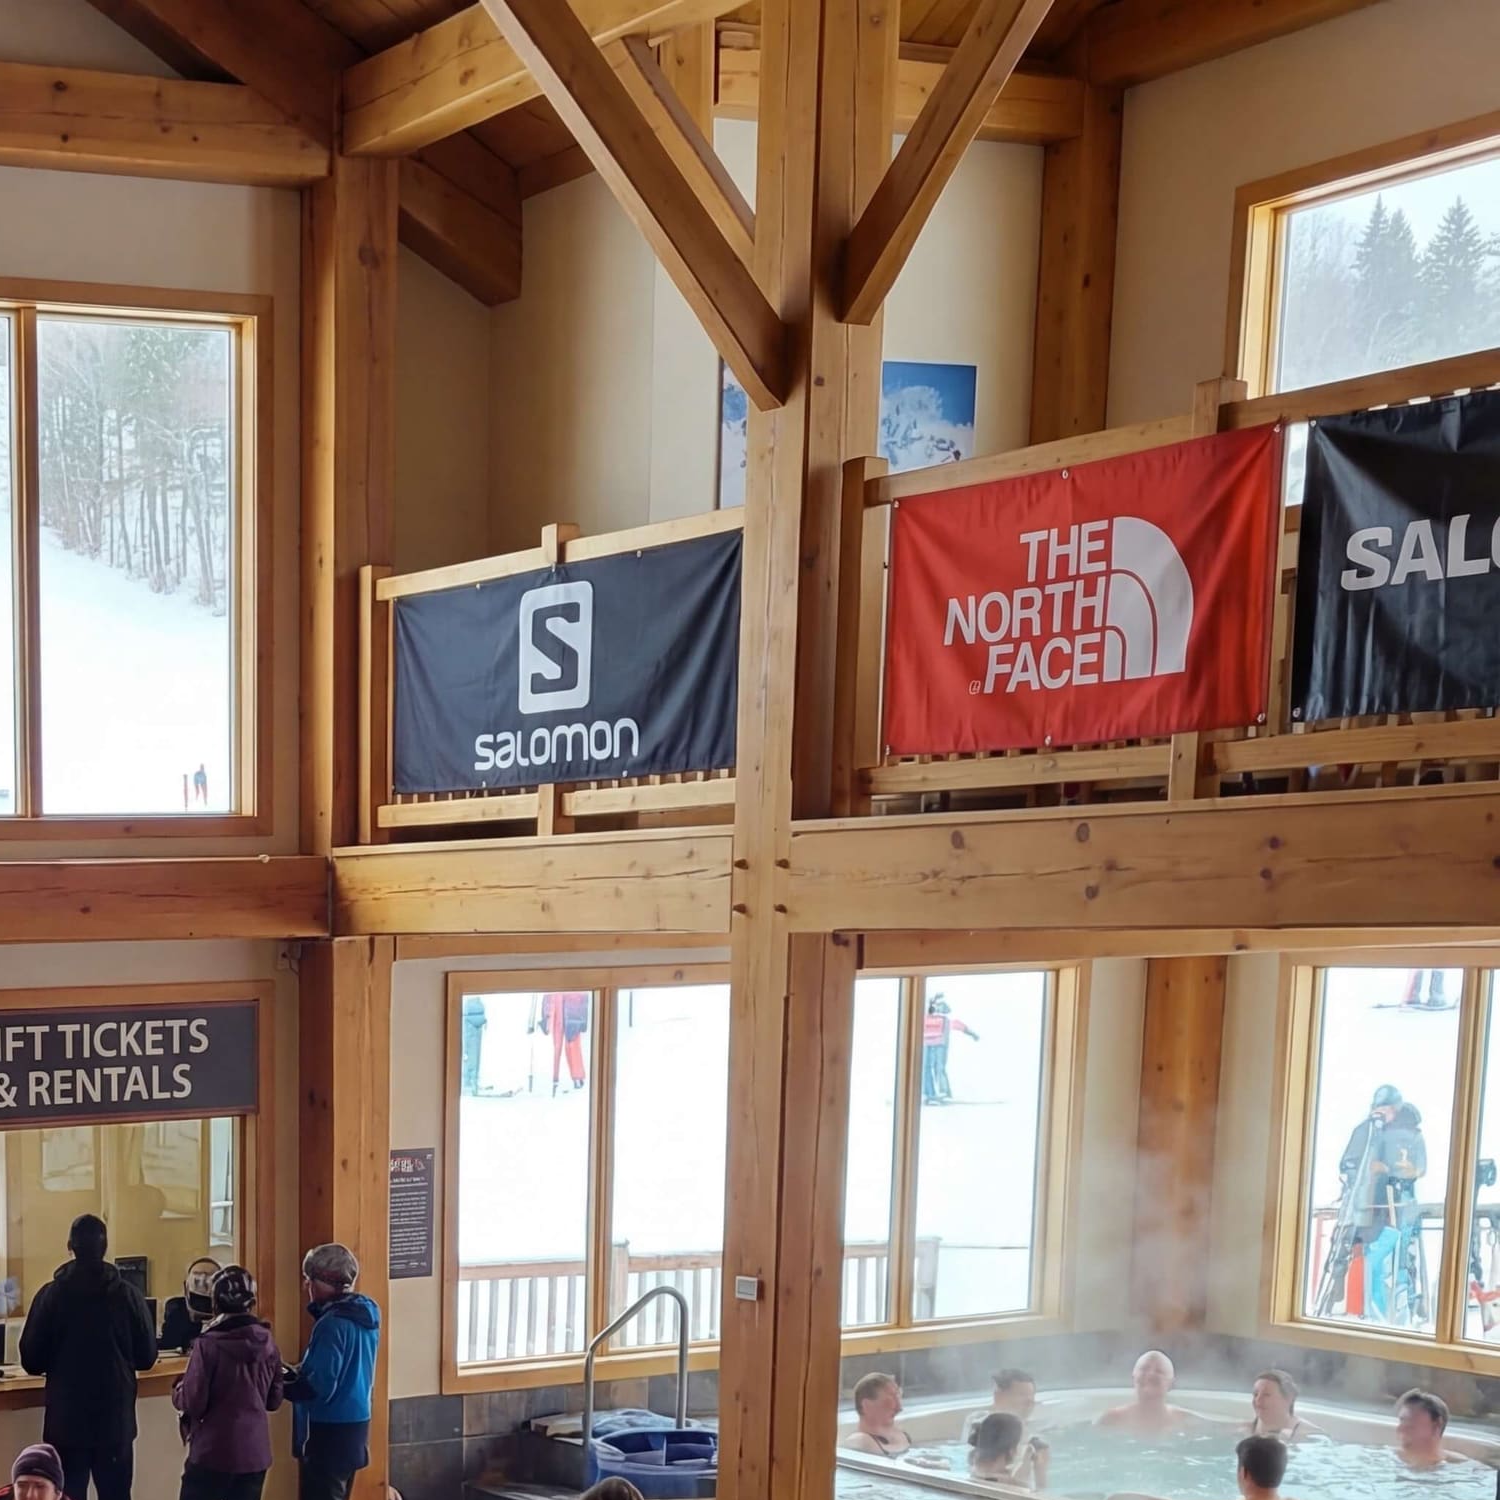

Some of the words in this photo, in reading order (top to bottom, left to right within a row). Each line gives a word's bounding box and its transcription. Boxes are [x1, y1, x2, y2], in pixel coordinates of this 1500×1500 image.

[1020, 519, 1108, 582] THE
[1341, 514, 1500, 591] SAL
[944, 576, 1106, 646] NORTH
[984, 632, 1101, 694] FACE
[474, 717, 639, 771] salomon
[57, 1018, 210, 1059] TICKETS
[28, 1063, 193, 1107] RENTALS
